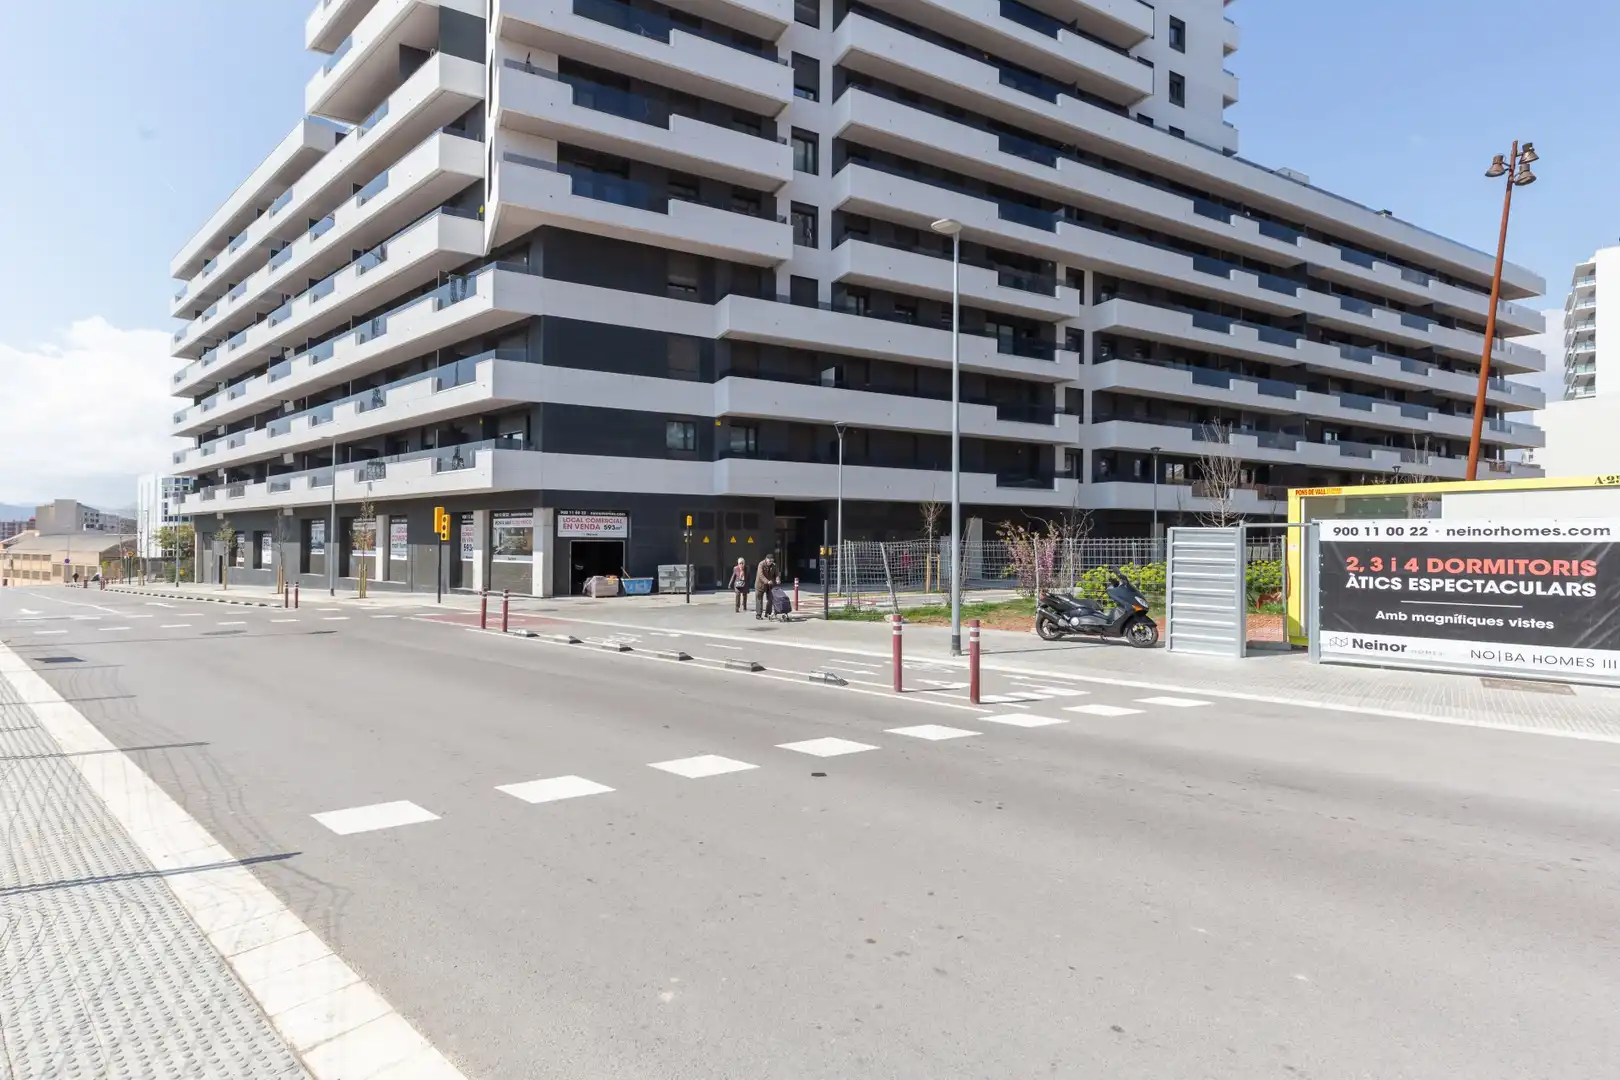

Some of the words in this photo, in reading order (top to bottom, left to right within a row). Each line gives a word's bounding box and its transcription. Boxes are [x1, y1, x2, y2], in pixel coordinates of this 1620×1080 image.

[1333, 527, 1359, 537] 900
[1364, 527, 1379, 537] 11
[1386, 527, 1405, 537] 00
[1409, 527, 1428, 537] 22
[1446, 526, 1611, 537] neinorhomes.com
[1370, 556, 1384, 572] 3
[1390, 557, 1397, 572] i
[1403, 557, 1420, 572] 4
[1426, 557, 1597, 577] DORMITORIS
[1345, 572, 1402, 590] ÀTICS
[1408, 577, 1597, 597] ESPECTACULARS
[1375, 610, 1408, 621] Amb
[1411, 613, 1504, 627] magnífiques
[1508, 617, 1555, 630] vistes
[1352, 638, 1408, 653] Neinor
[1532, 654, 1596, 668] HOMES
[1603, 659, 1617, 669] III
